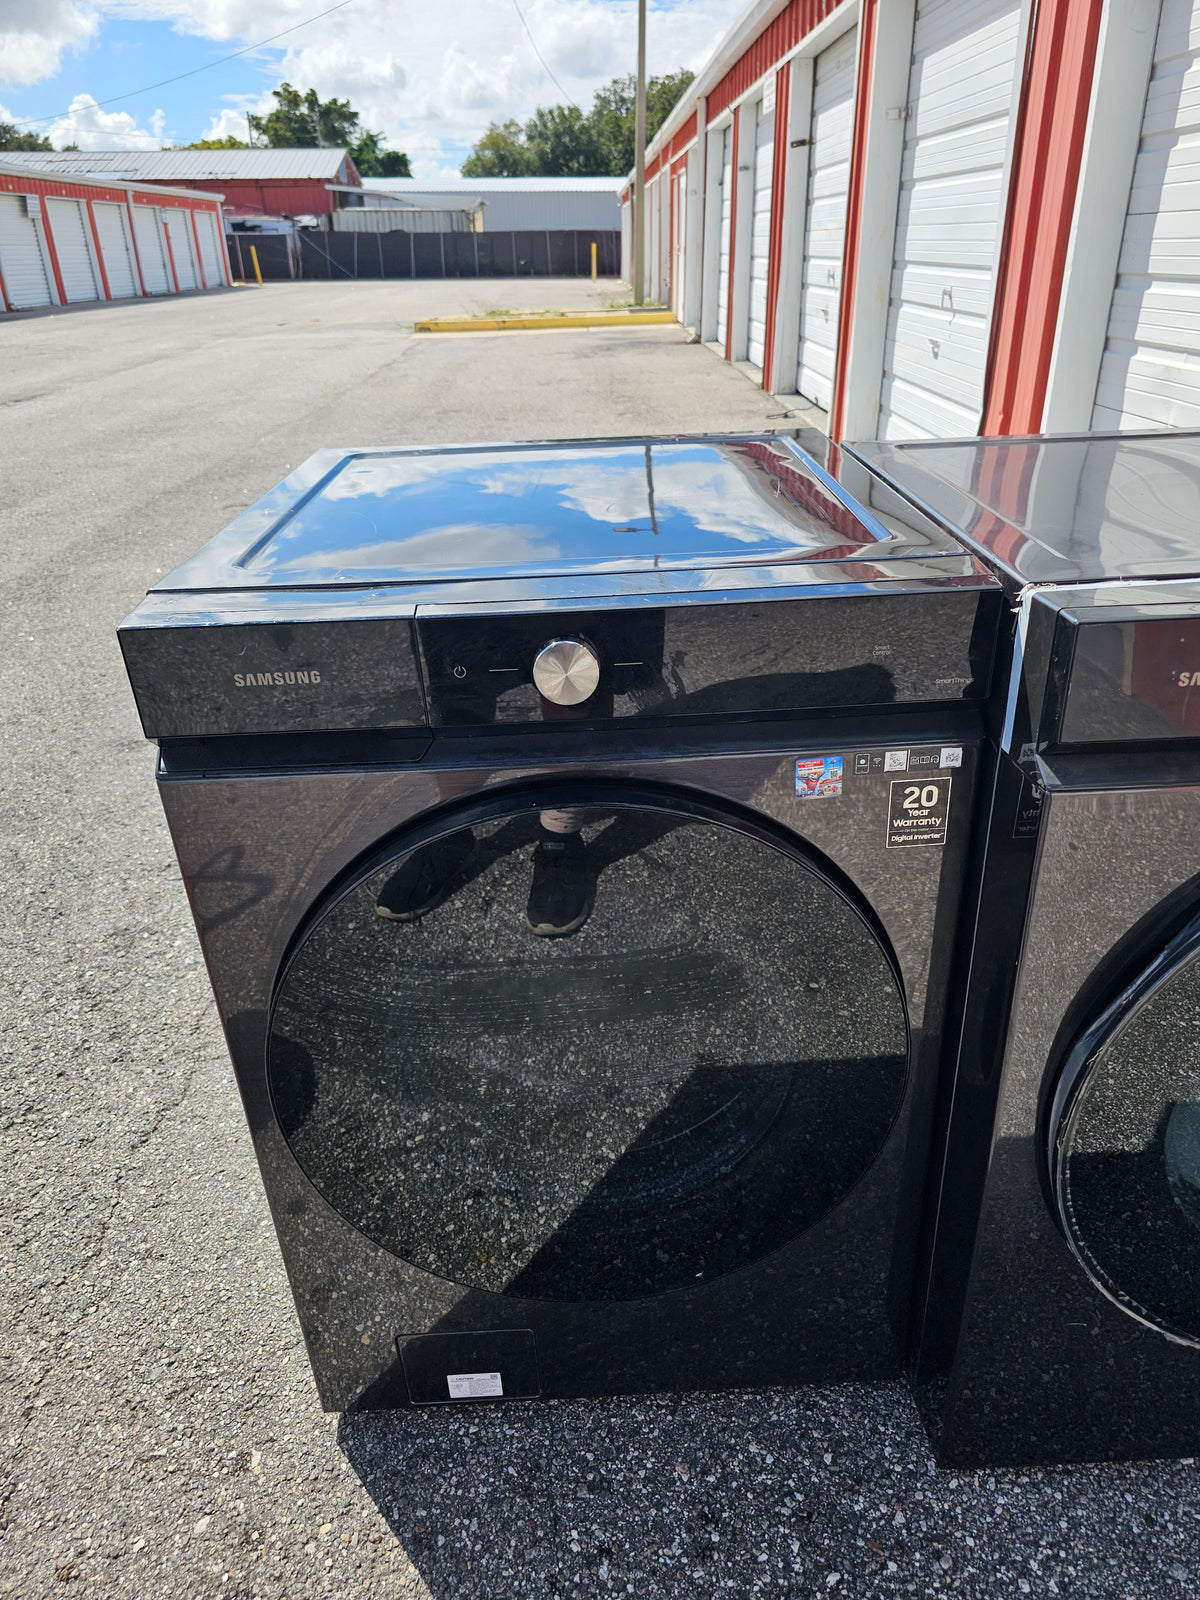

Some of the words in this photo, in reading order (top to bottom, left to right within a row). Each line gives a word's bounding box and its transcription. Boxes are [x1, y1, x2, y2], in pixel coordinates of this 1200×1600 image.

[233, 670, 321, 687] SAMSUNG
[903, 785, 939, 808] 20
[893, 817, 942, 827] Warranty
